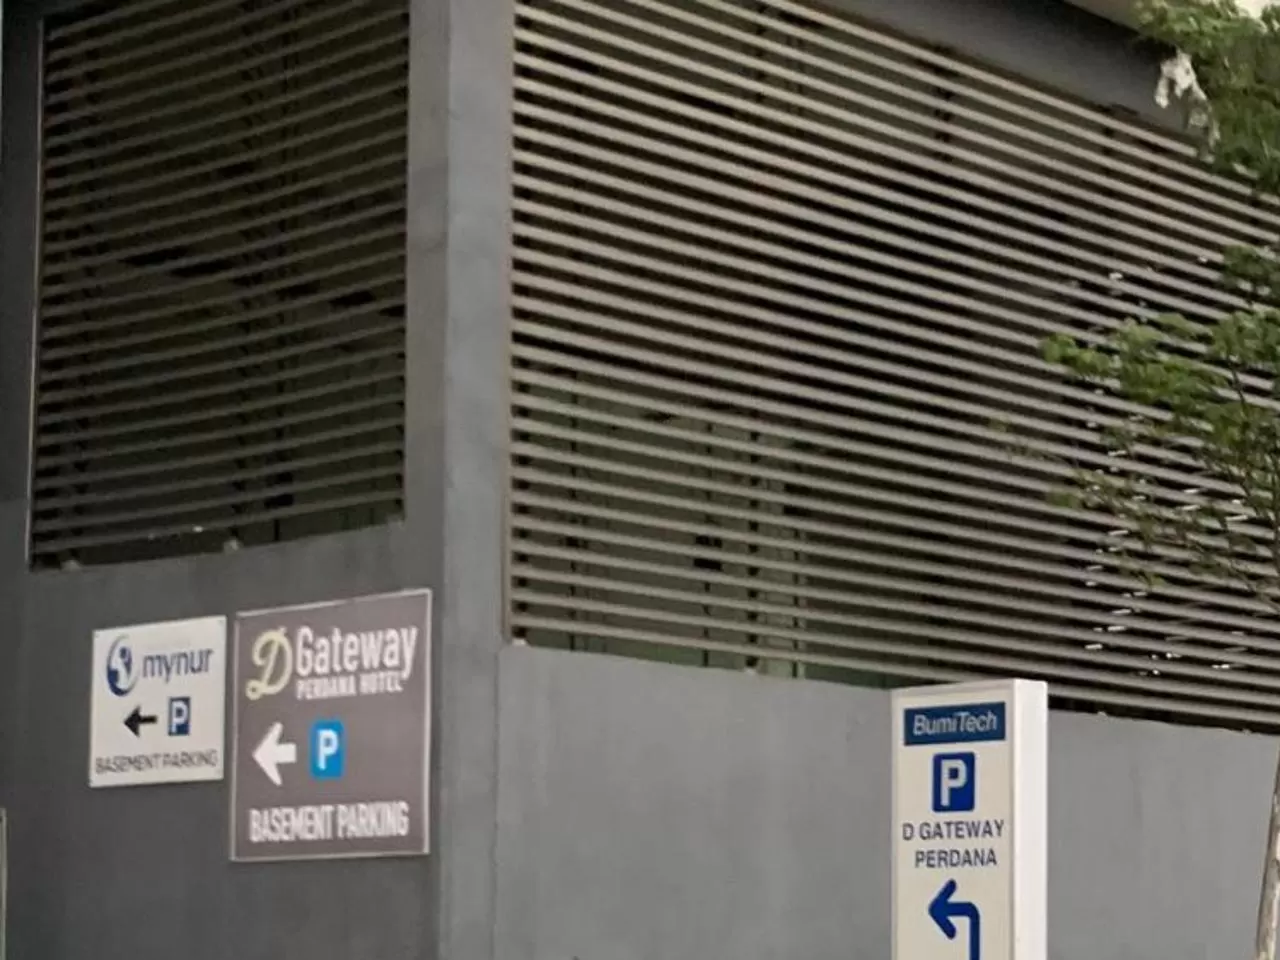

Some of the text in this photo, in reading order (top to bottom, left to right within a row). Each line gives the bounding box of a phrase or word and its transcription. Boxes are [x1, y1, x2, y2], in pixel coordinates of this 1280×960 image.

[142, 649, 213, 684] mynur
[296, 625, 418, 681] Gateway
[360, 671, 403, 694] HOTEL
[171, 700, 188, 733] P
[912, 709, 998, 736] BumiTech
[95, 749, 218, 774] BASEMENT PARKING
[316, 729, 338, 769] P
[940, 759, 967, 807] P
[249, 801, 409, 843] BASEMENT PARKING
[902, 819, 1004, 841] D GATEWAY
[915, 848, 998, 869] PERDANA
